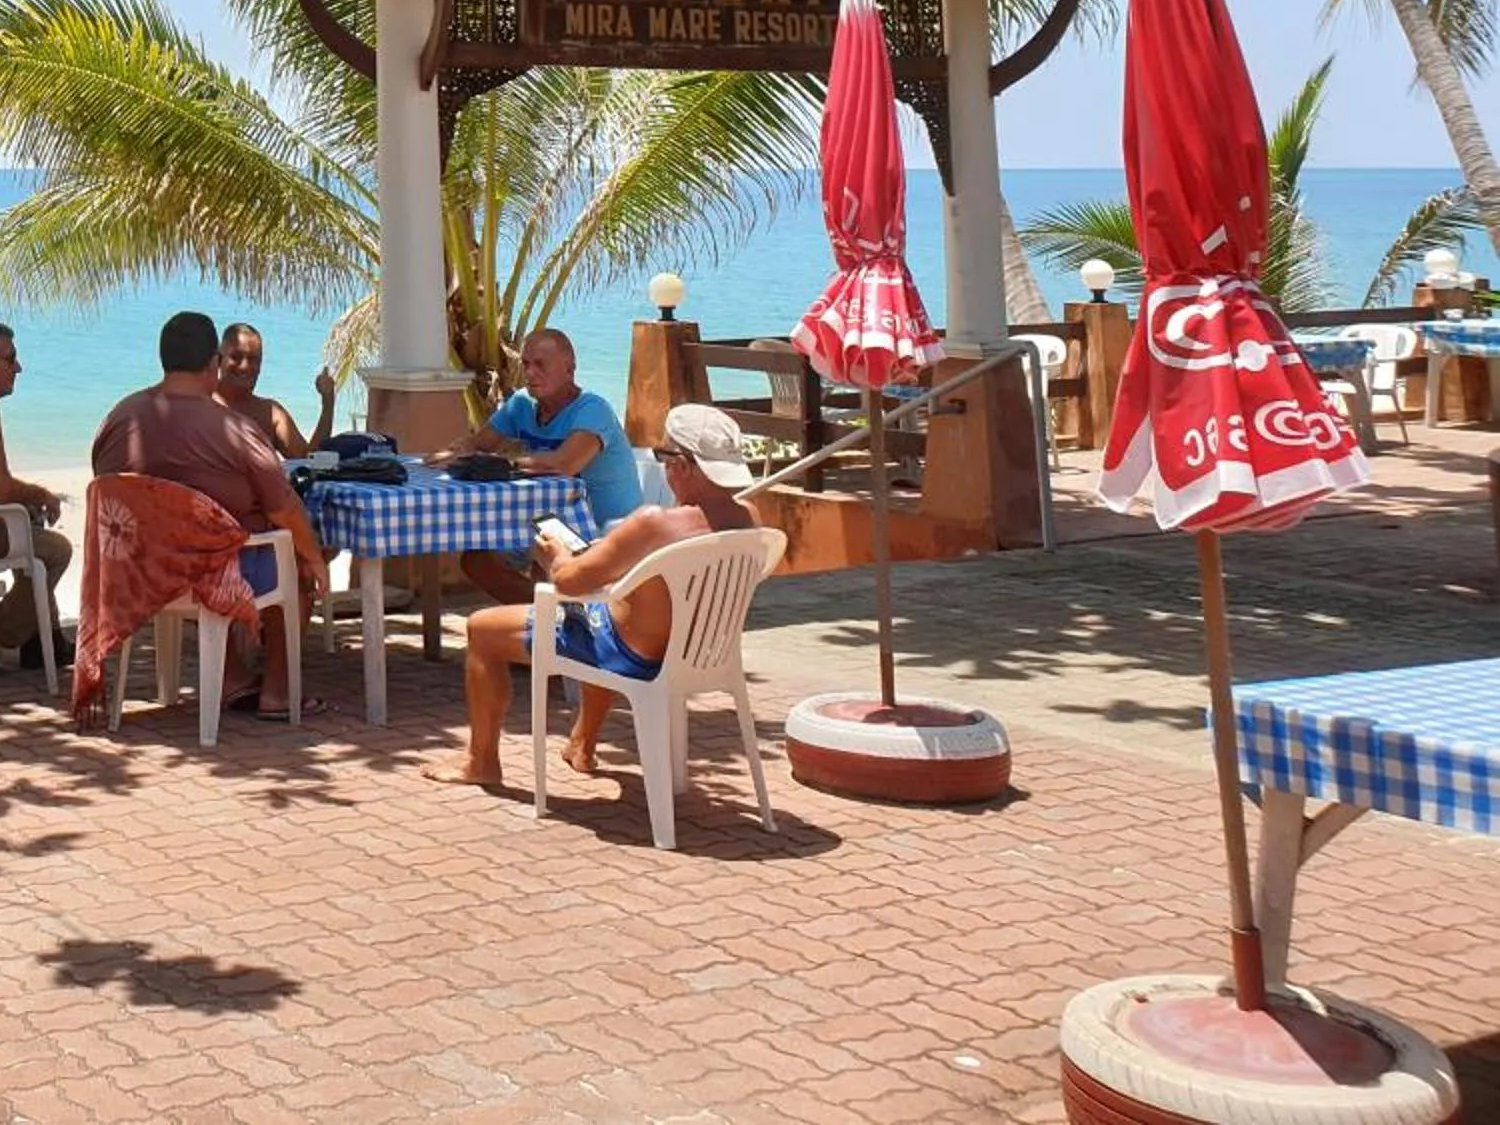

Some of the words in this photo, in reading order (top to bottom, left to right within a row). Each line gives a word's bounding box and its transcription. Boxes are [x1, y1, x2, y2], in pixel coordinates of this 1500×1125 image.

[565, 3, 634, 37] MIRA
[649, 6, 722, 41] MARE
[734, 10, 837, 46] RESORT
